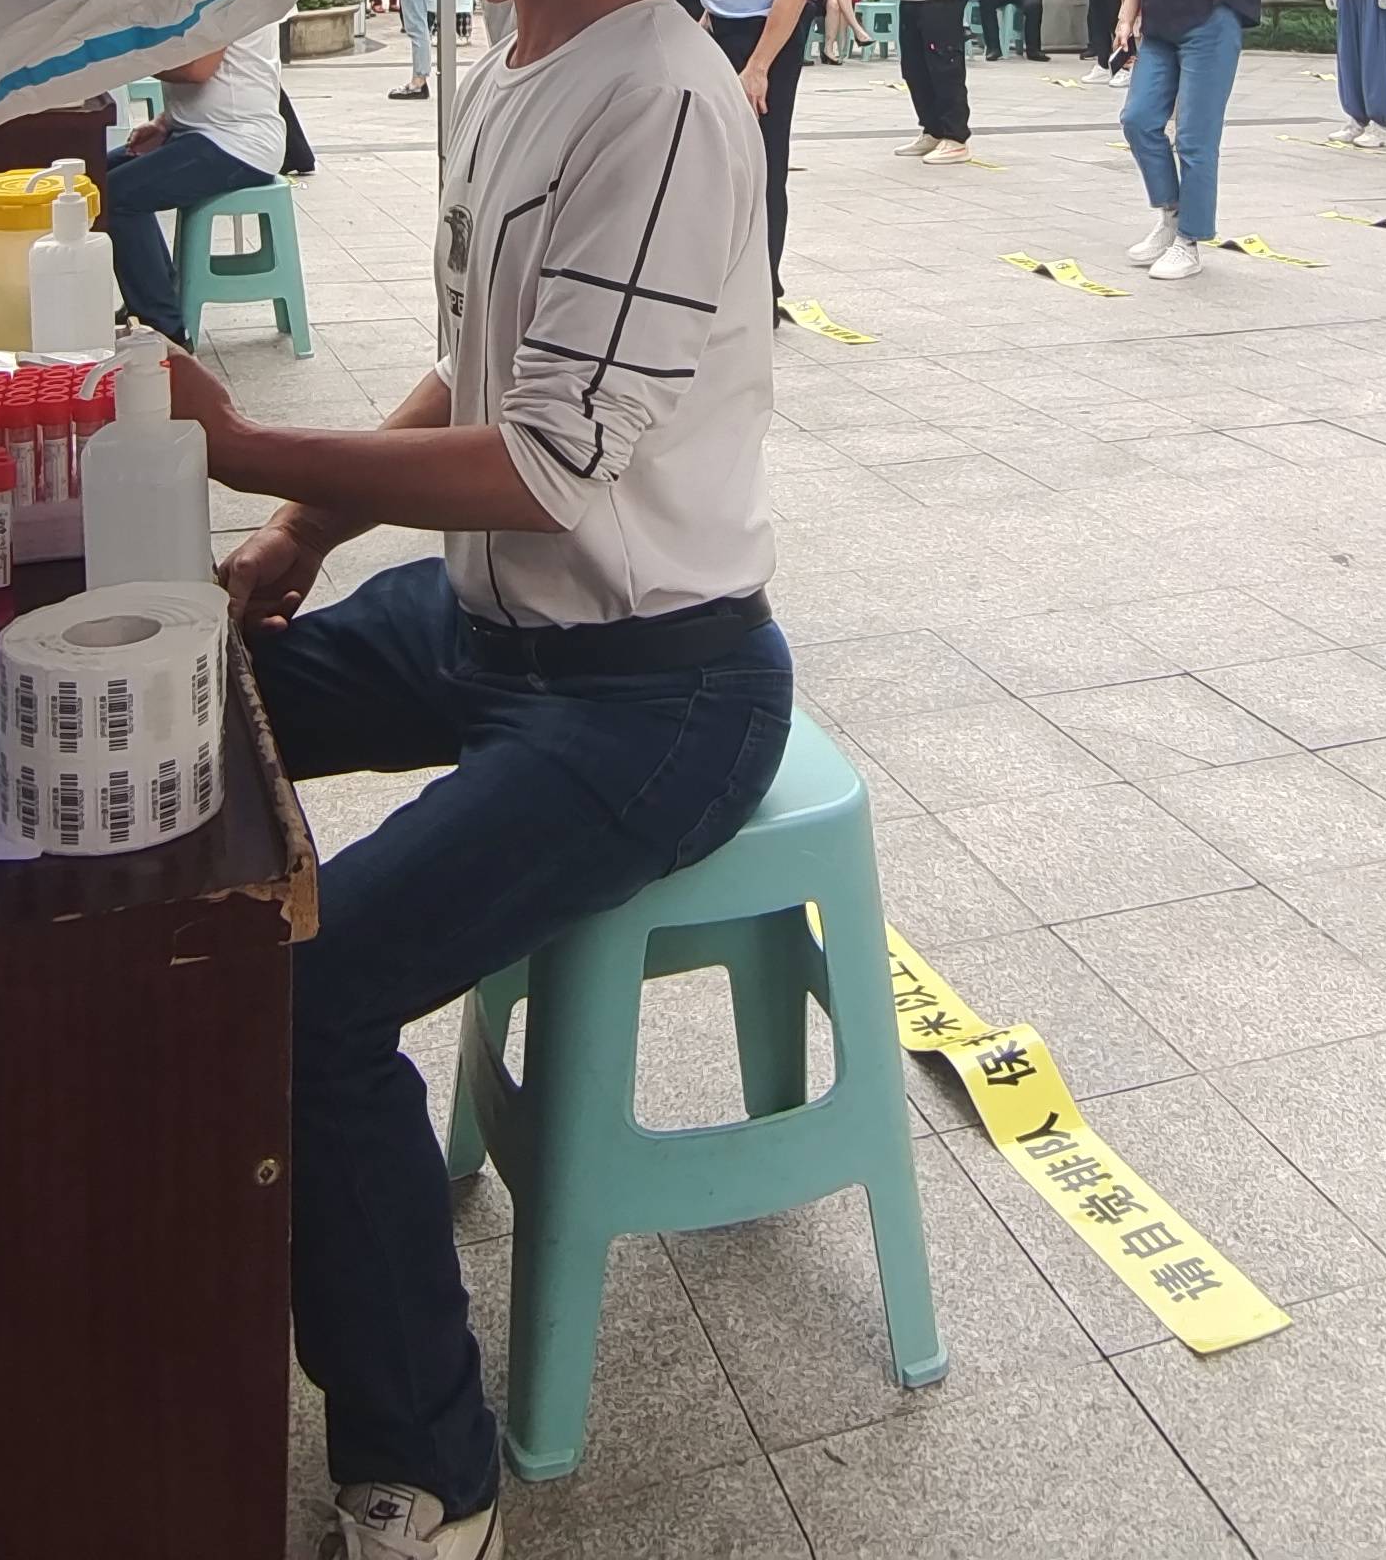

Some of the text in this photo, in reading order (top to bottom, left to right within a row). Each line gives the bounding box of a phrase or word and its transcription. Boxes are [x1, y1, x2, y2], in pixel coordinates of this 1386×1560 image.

[1015, 1110, 1223, 1303] 请自觉排队
